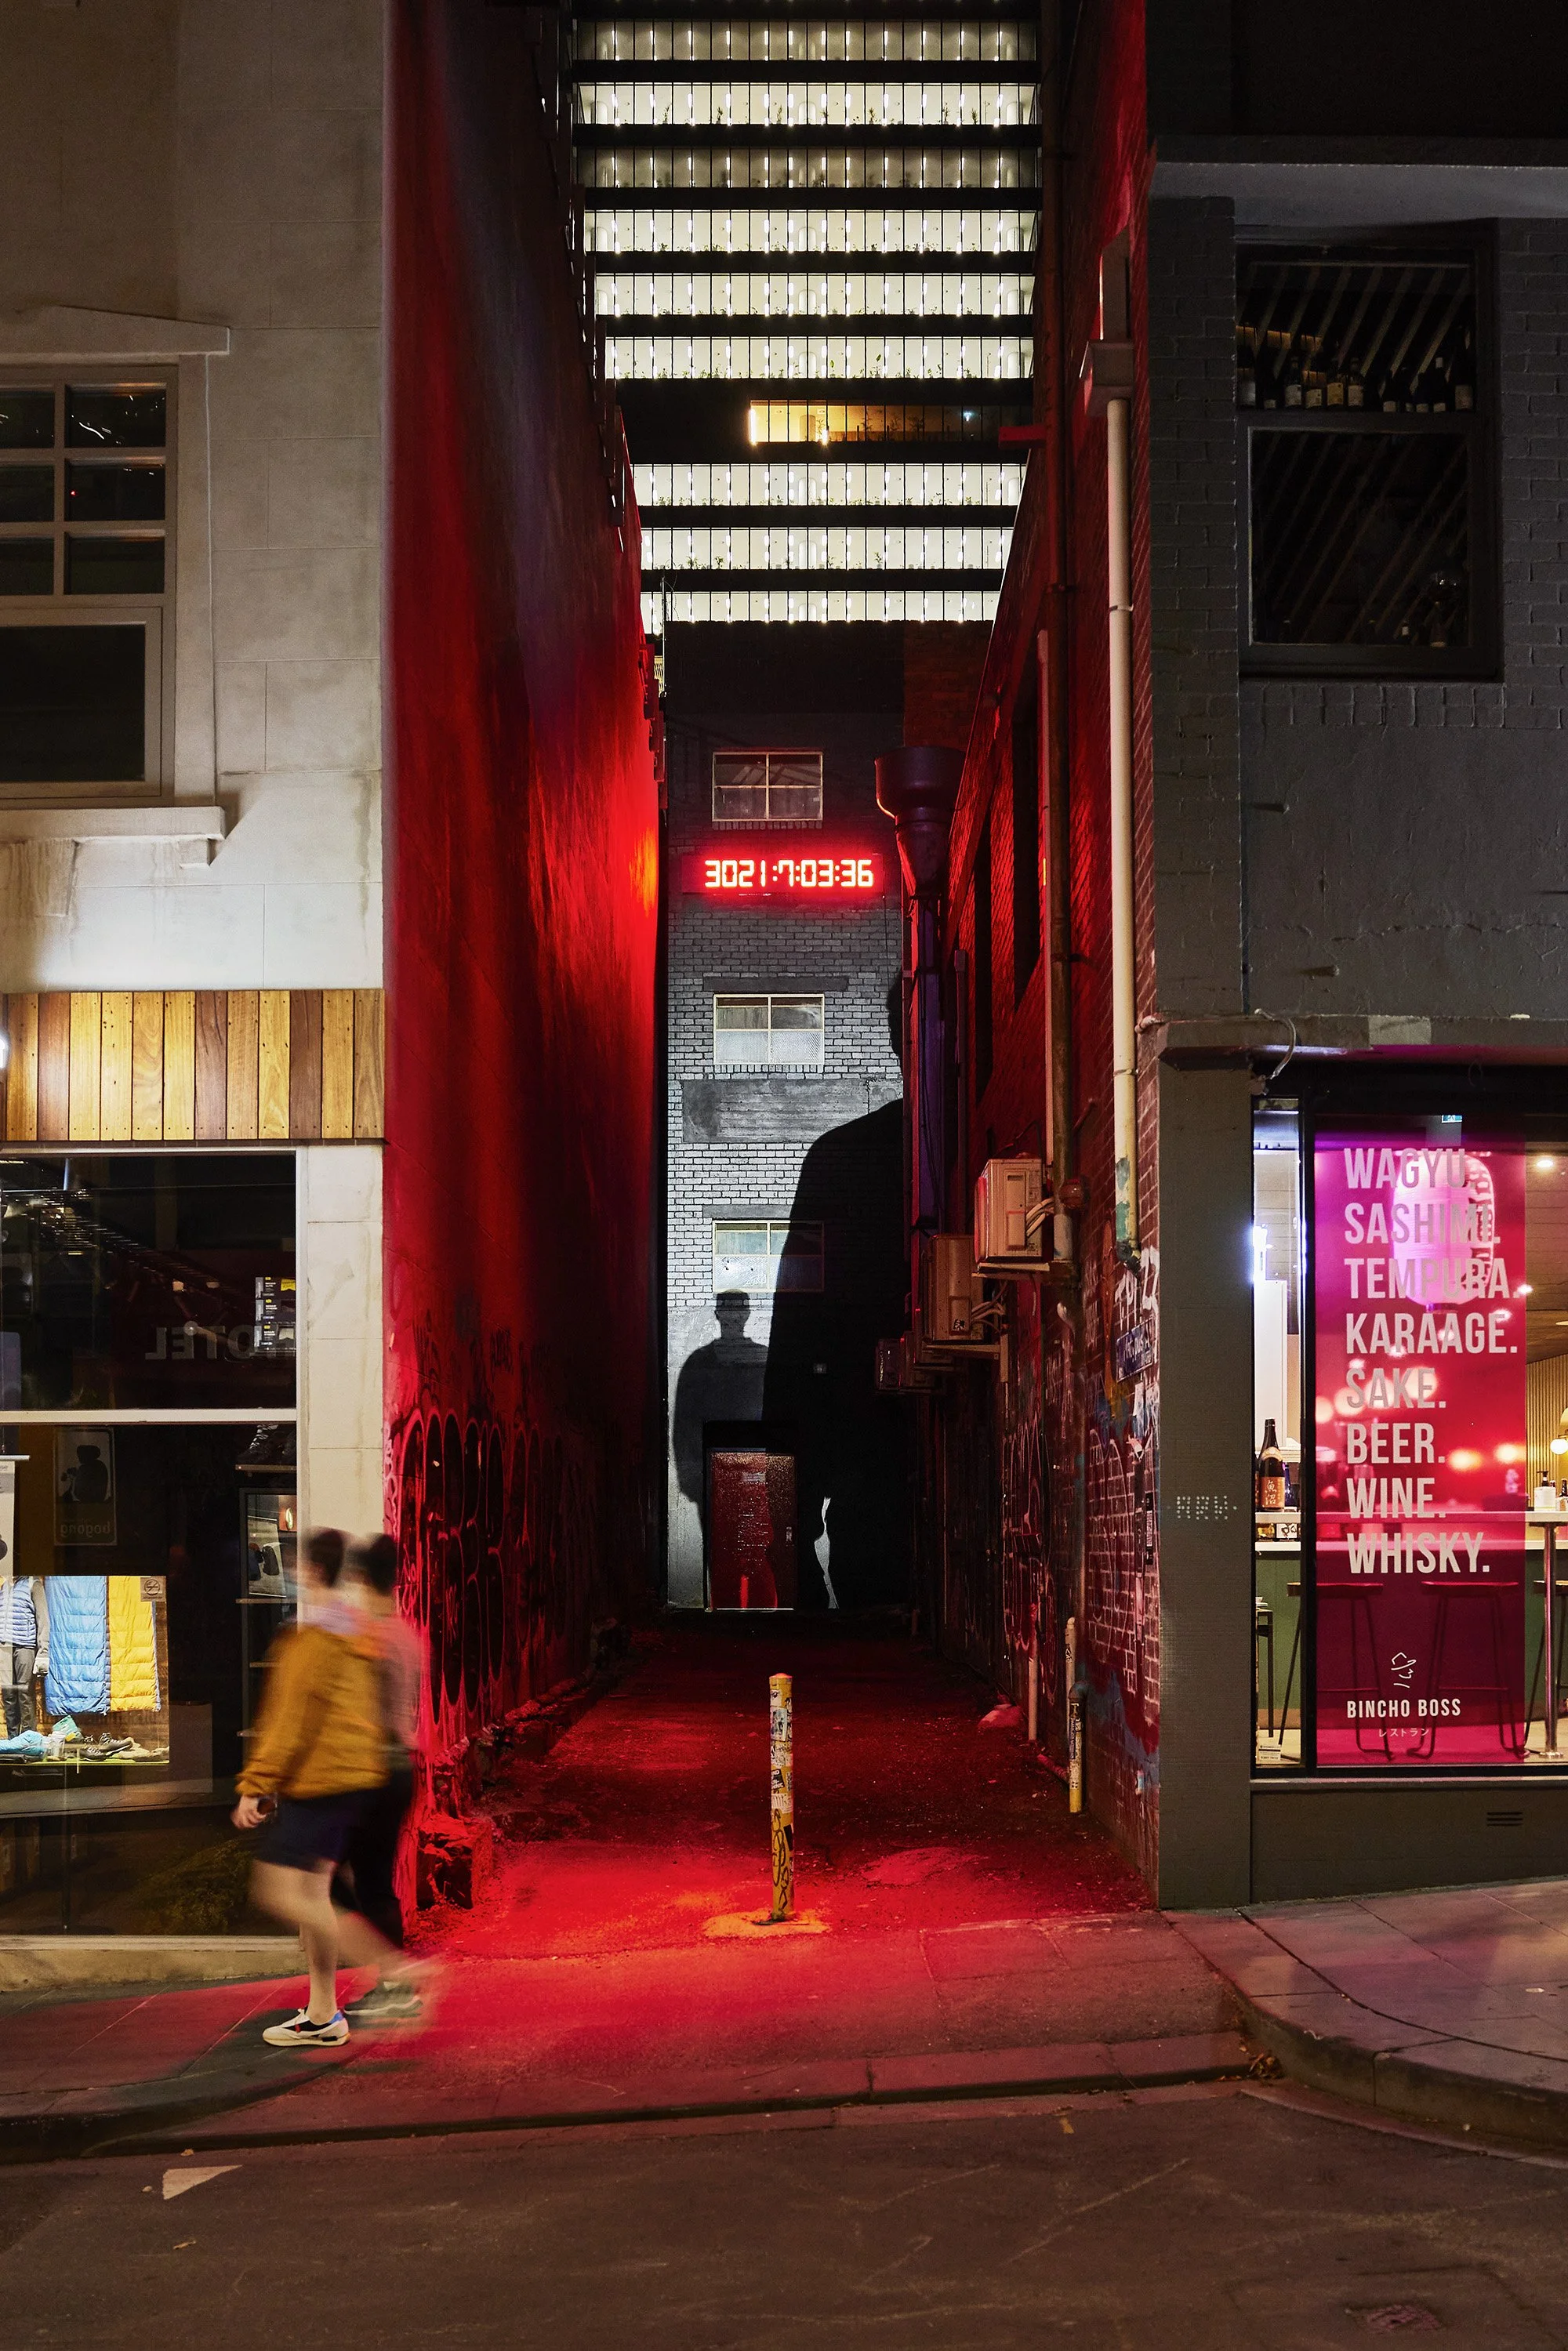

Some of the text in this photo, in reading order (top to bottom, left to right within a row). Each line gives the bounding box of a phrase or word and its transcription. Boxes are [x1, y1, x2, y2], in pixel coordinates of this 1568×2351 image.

[1345, 1148, 1475, 1188] WAGYU.
[1345, 1203, 1501, 1244] SASHIMI.
[1345, 1258, 1521, 1299] TEMPURA.
[1347, 1313, 1518, 1353] KARAAGE.
[1346, 1368, 1446, 1409] SAKE.
[1347, 1423, 1446, 1464] BEER.
[1347, 1478, 1446, 1518] WINE.
[1347, 1532, 1490, 1574] WHISKY.
[1347, 1699, 1461, 1718] BINCHO BOSS
[1379, 1728, 1429, 1738] レストラン
